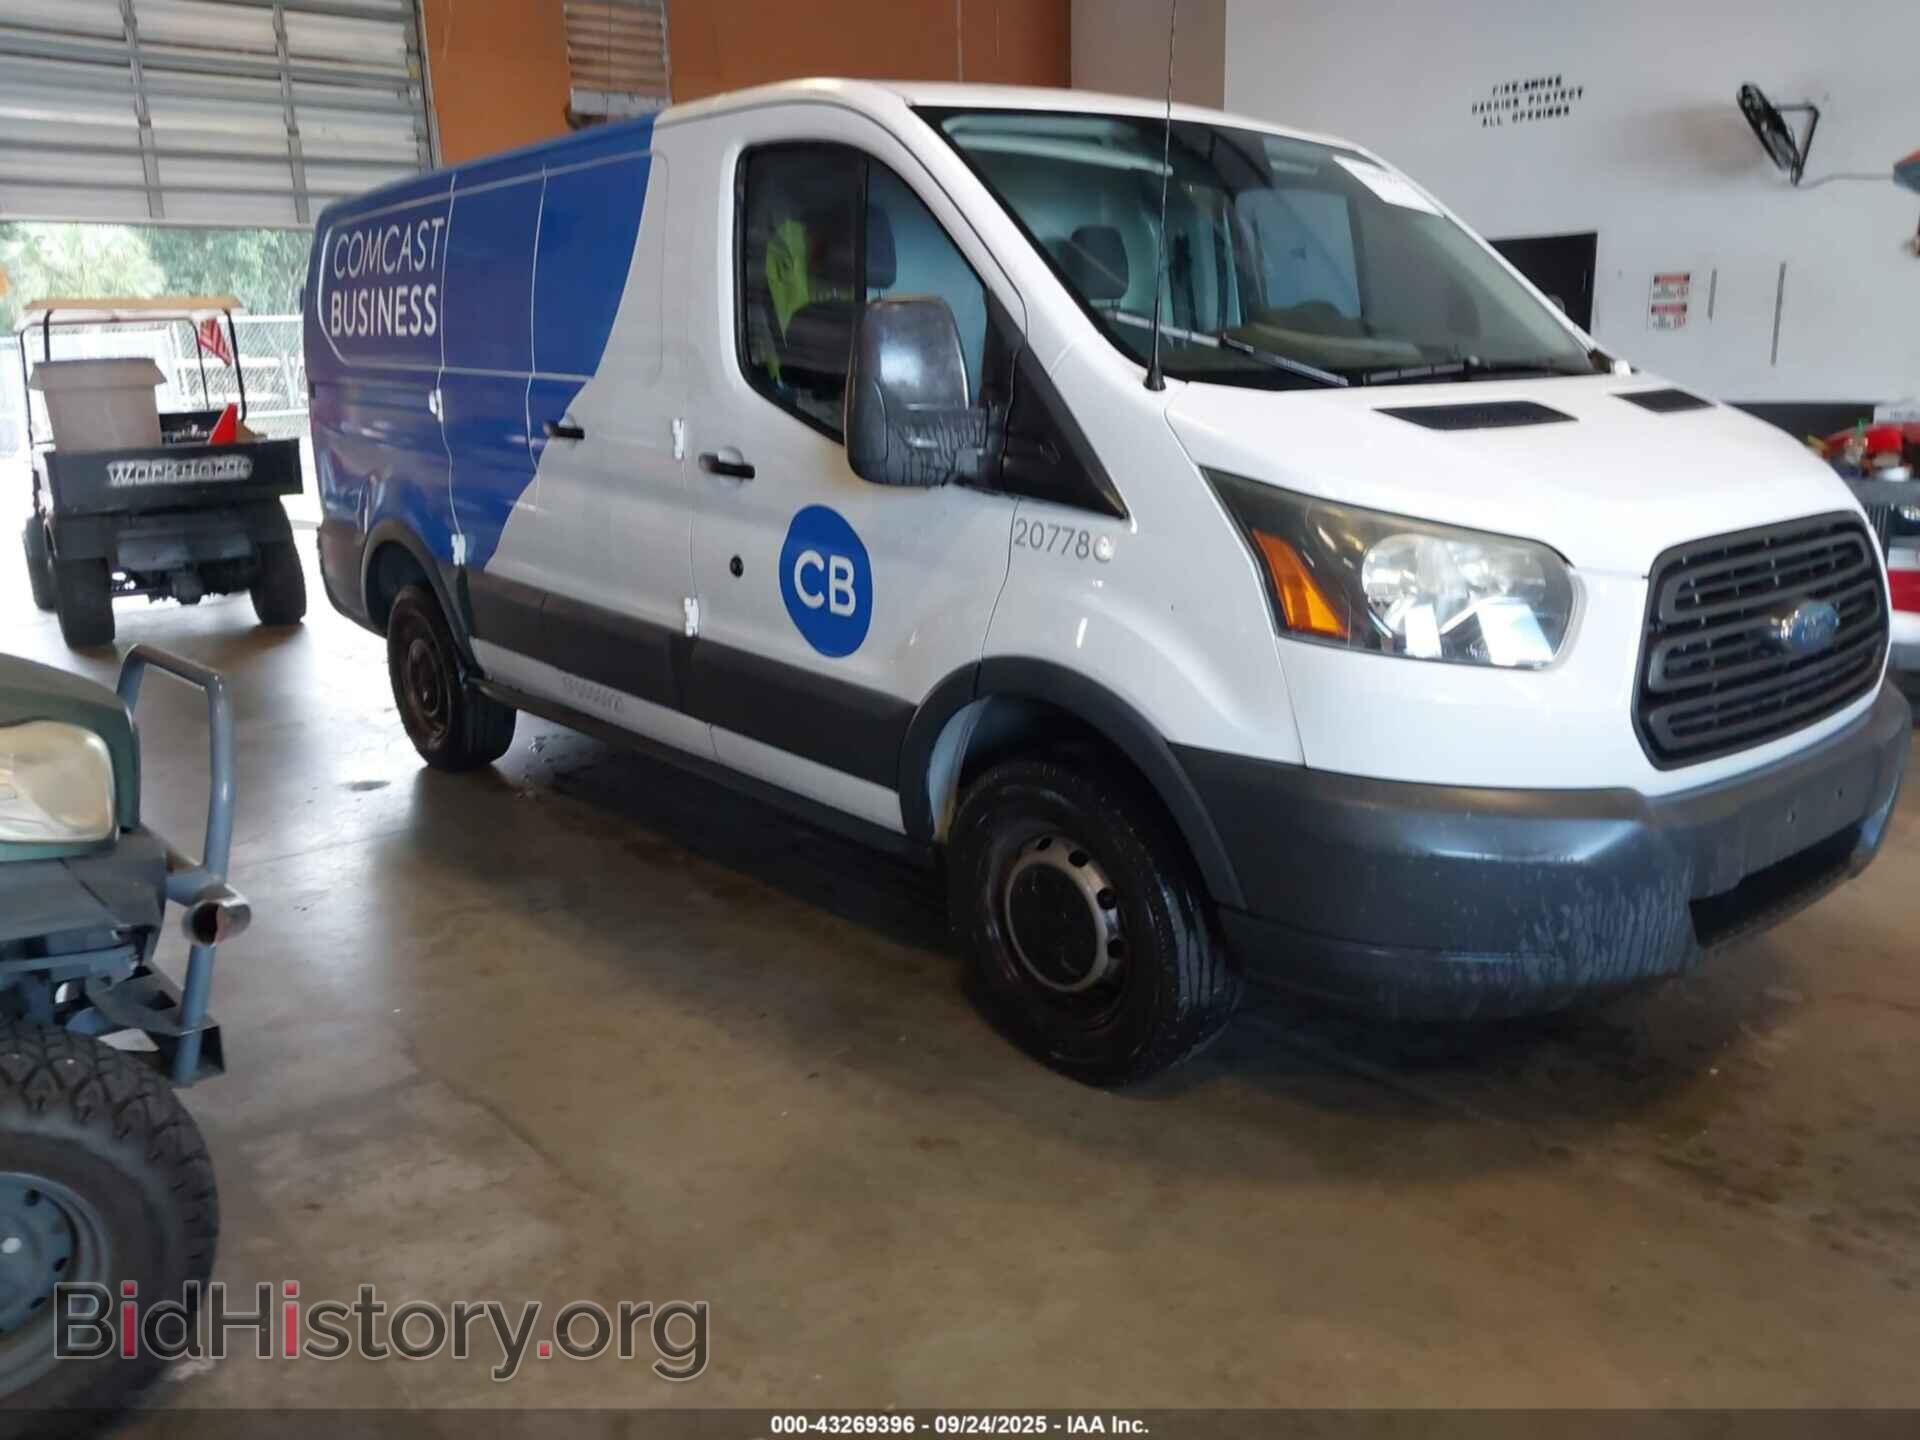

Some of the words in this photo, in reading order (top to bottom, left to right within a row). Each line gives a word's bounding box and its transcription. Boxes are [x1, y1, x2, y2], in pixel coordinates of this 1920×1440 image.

[334, 216, 445, 280] COMCAST
[331, 283, 437, 337] BUSINESS
[793, 549, 856, 617] CB
